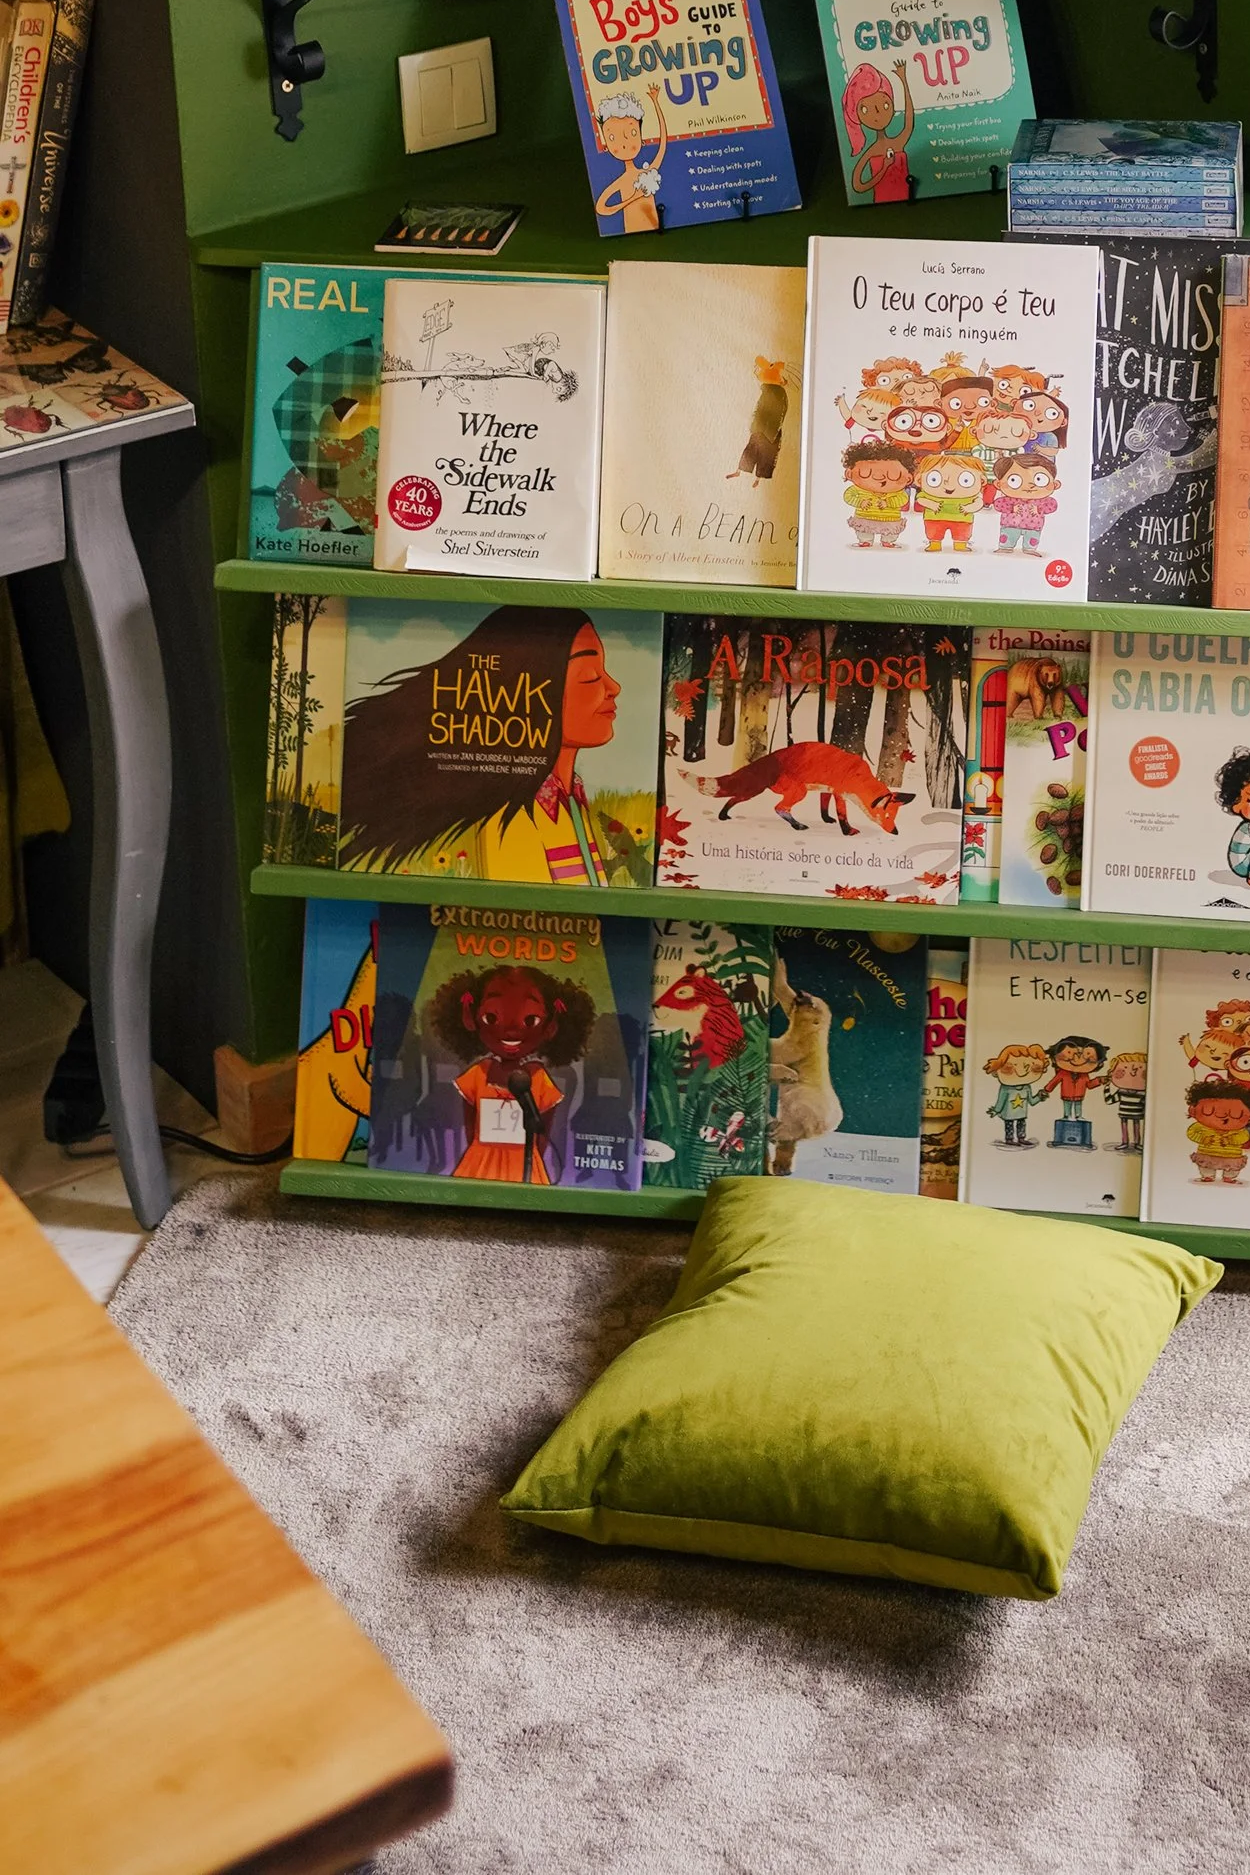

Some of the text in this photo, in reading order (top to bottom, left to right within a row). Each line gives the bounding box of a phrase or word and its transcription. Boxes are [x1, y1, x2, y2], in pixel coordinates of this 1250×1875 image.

[688, 3, 737, 24] GUIDE
[702, 21, 721, 36] TO
[914, 47, 971, 87] UP
[664, 71, 719, 106] UP
[687, 112, 747, 128] Phil Wilkinson
[922, 261, 985, 274] Lucía Serrano
[267, 277, 369, 314] REAL
[853, 275, 1056, 323] O teu corpo é teu
[888, 323, 1017, 344] e de mais ninguém
[458, 412, 538, 440] Where
[479, 441, 517, 465] the
[435, 456, 555, 493] Sidewalk
[406, 488, 427, 503] 40
[463, 491, 527, 517] Ends
[395, 500, 433, 517] YEARS
[256, 536, 358, 556] Kate Hoefler
[440, 540, 539, 559] Shel Silverstein
[468, 654, 501, 671] THE
[706, 634, 931, 693] A Raposa
[432, 669, 553, 716] HAWK
[1112, 669, 1216, 715] SABIA
[429, 713, 552, 750] SHADOW
[701, 843, 914, 869] Uma história sobre o ciclo da vida
[1105, 863, 1196, 881] CORI DOERRFELD
[430, 905, 602, 943] Extraordinary
[456, 934, 578, 963] WORDS
[585, 1143, 614, 1156] KITT
[823, 1149, 899, 1164] Nancy Tillman
[574, 1157, 625, 1172] THOMAS
